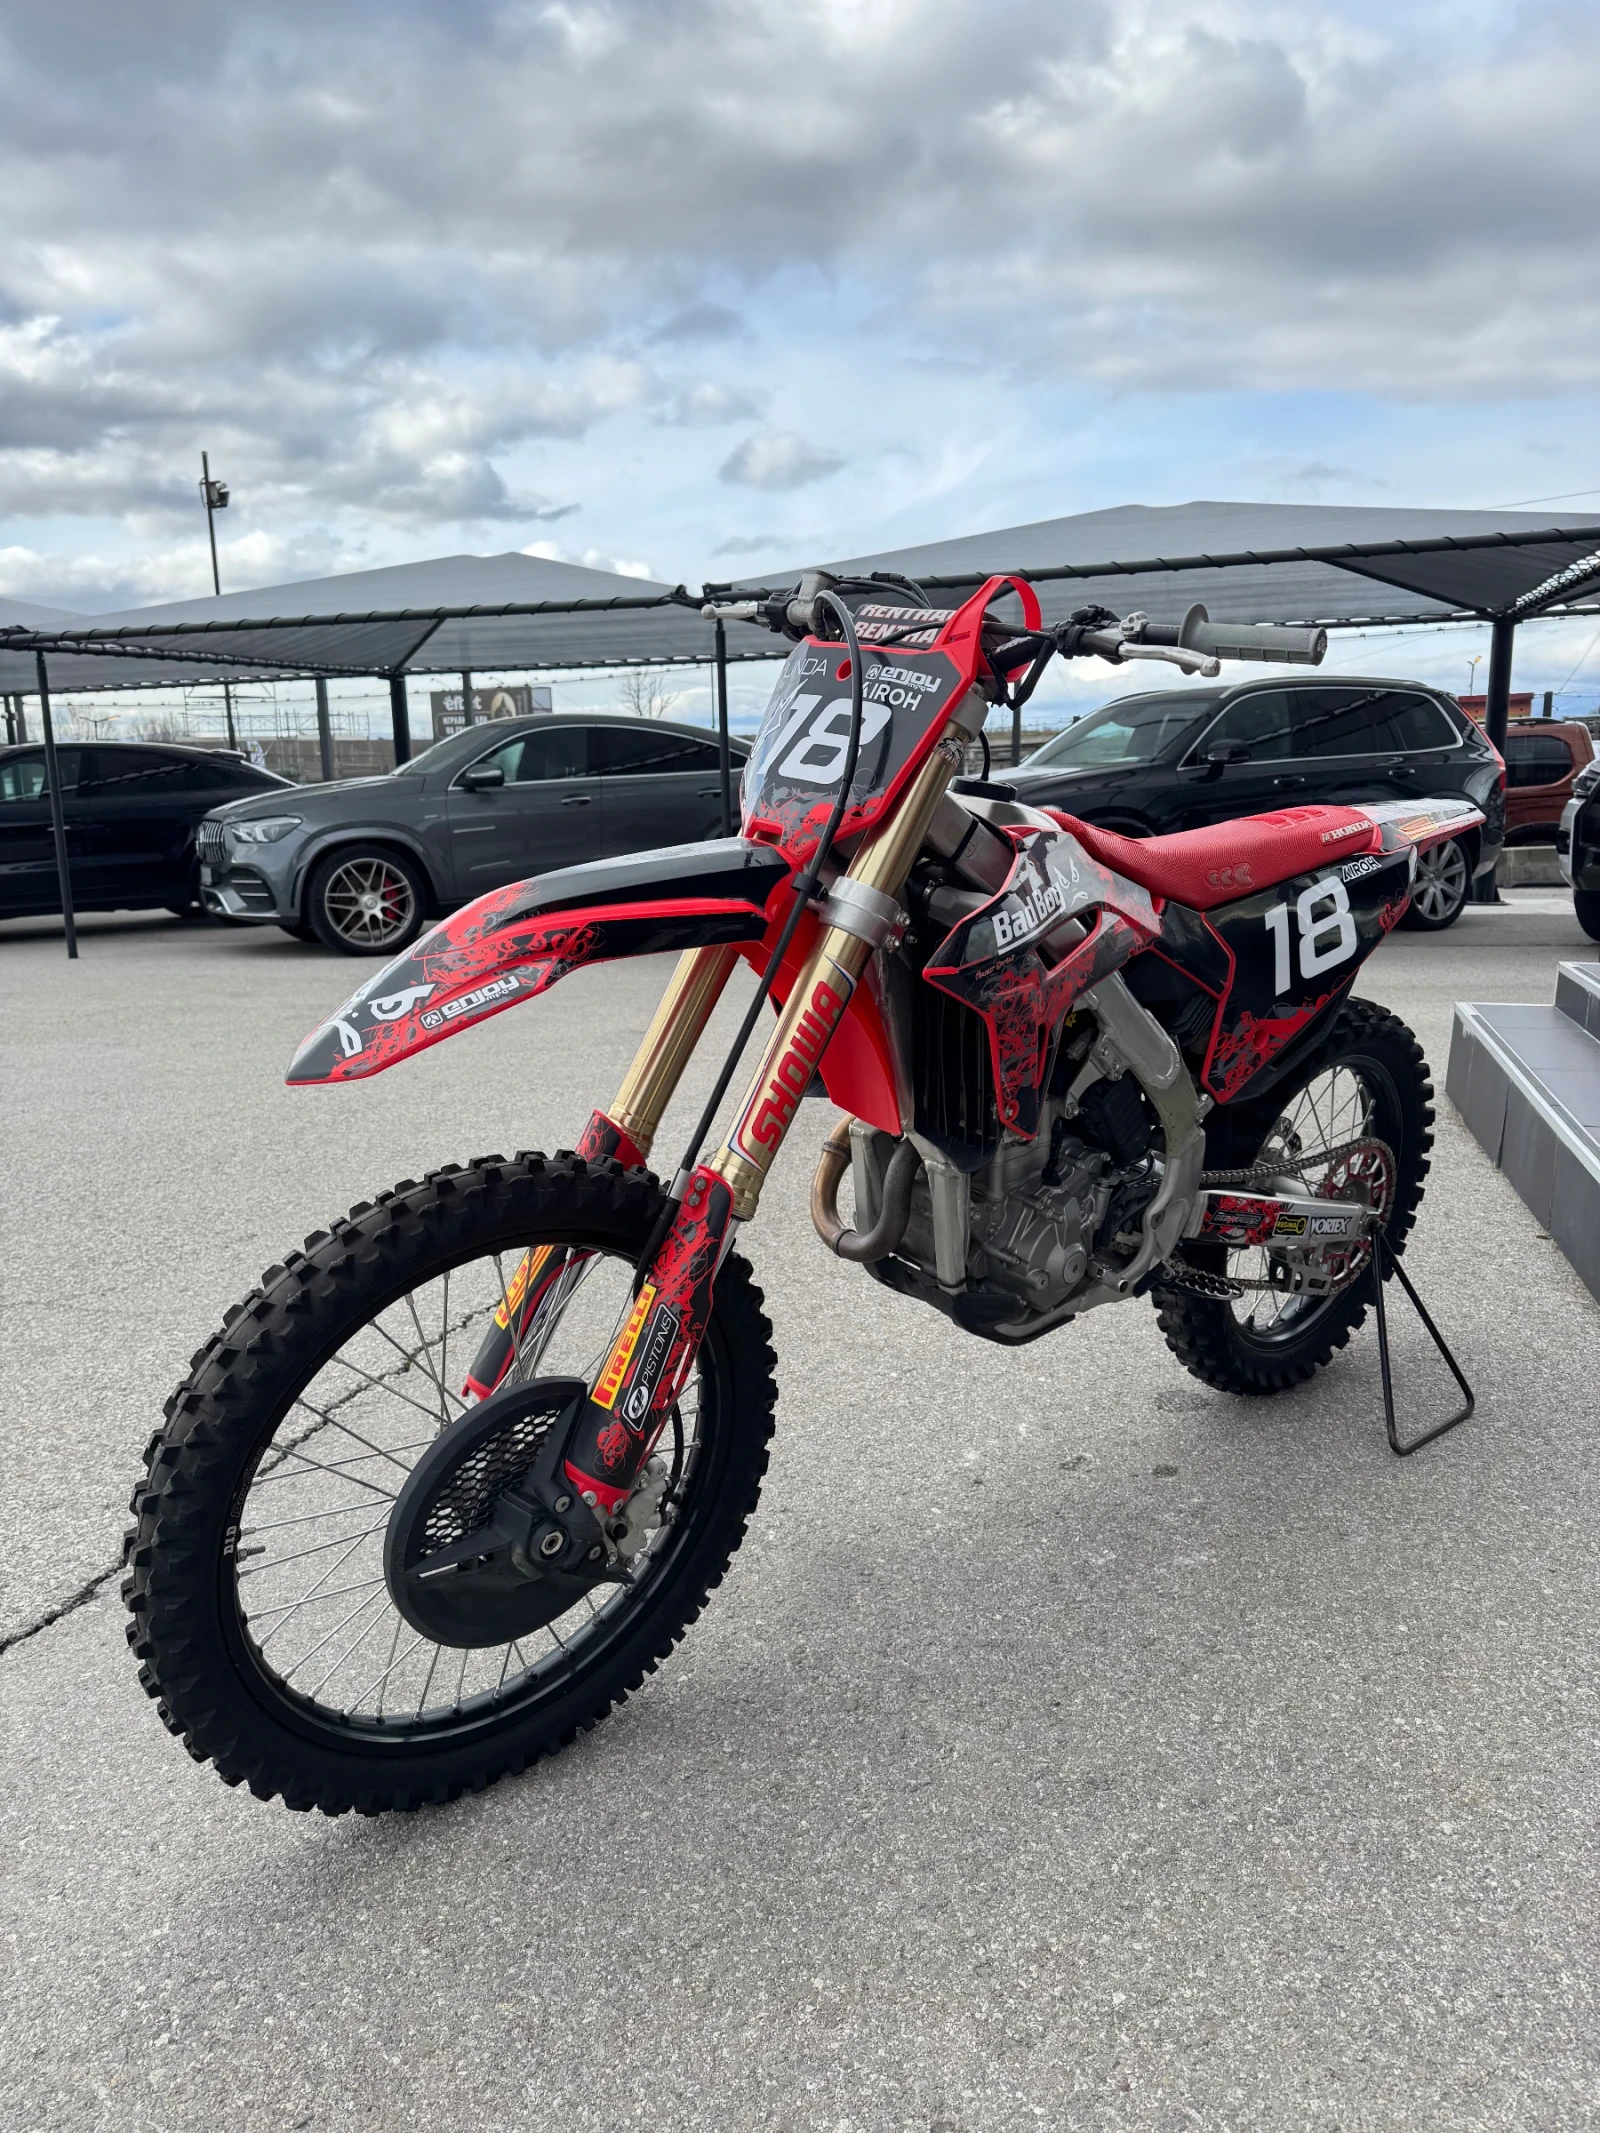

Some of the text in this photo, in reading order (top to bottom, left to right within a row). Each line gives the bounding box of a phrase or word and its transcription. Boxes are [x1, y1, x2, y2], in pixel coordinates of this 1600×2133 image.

[855, 622, 939, 644] RENHA
[757, 694, 892, 784] 18
[1333, 820, 1373, 839] HONDA
[1342, 856, 1382, 882] AIROH
[1265, 875, 1357, 996] 18
[752, 980, 844, 1154] SHOWA
[1310, 1216, 1352, 1236] VORTEX
[593, 1288, 653, 1405] PIRELLI
[641, 1314, 672, 1387] PISTONS
